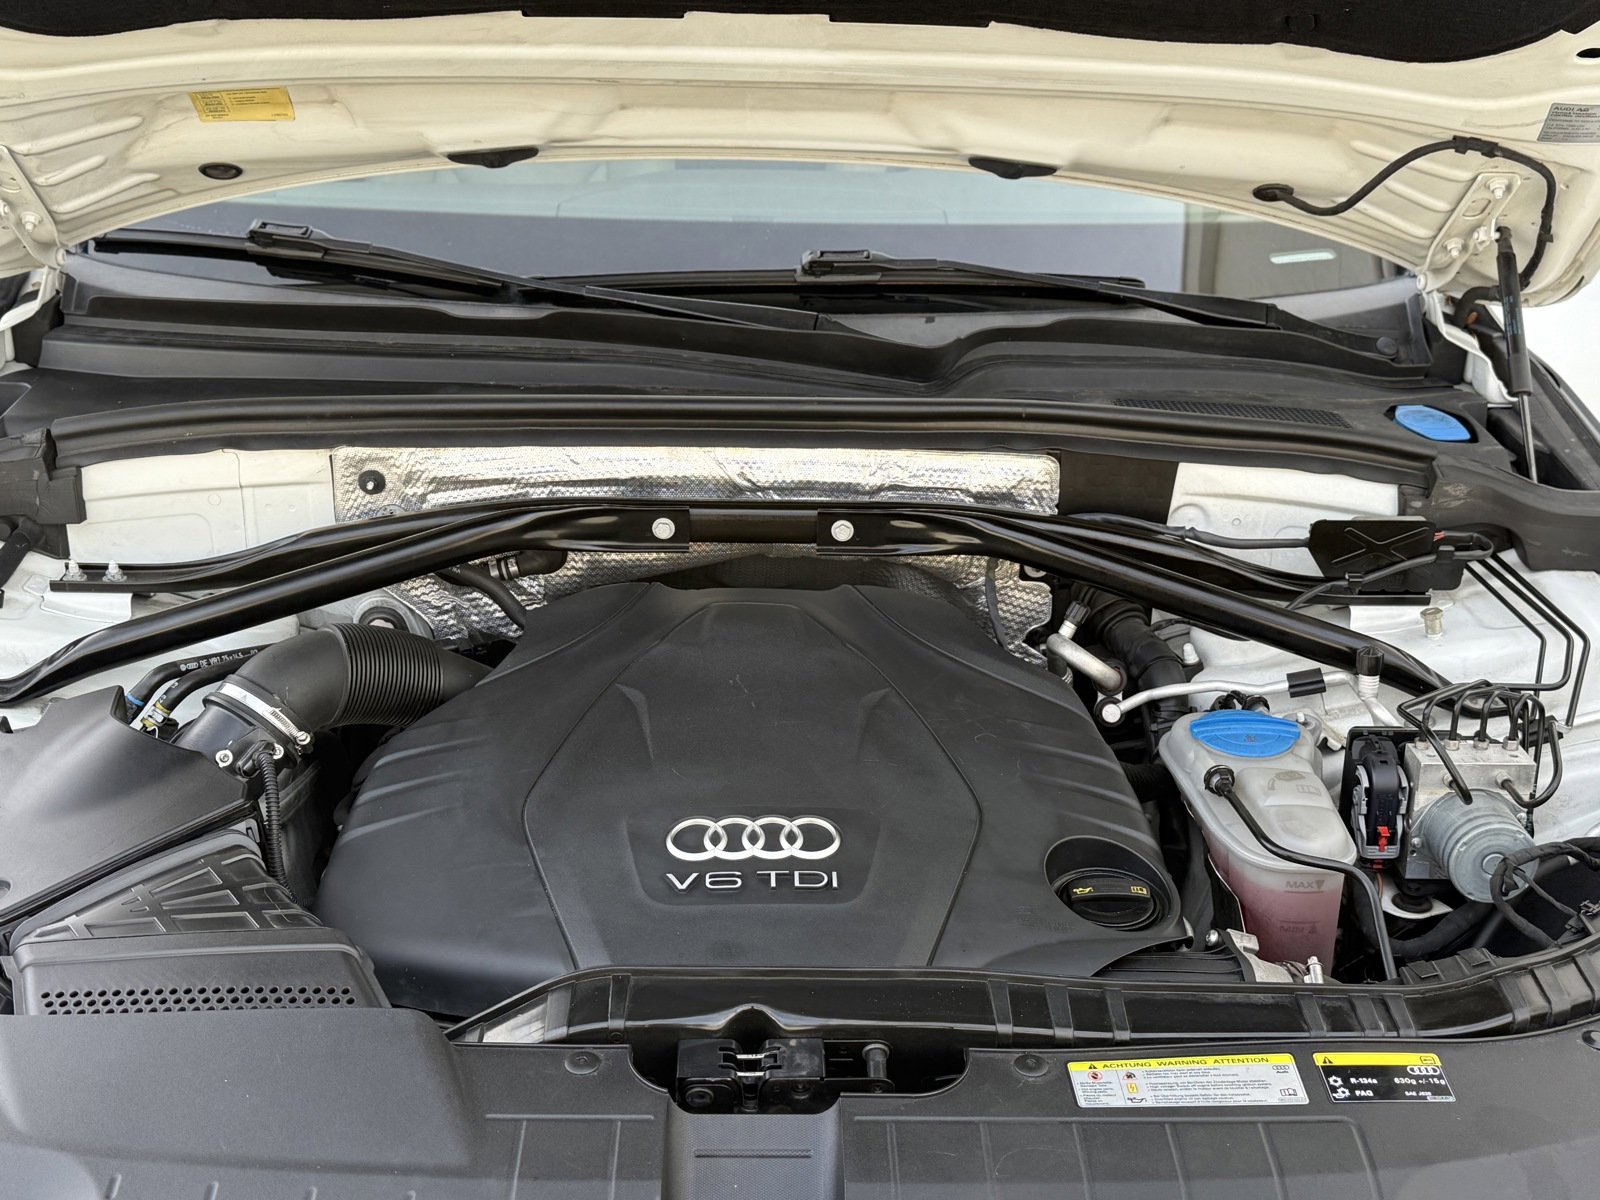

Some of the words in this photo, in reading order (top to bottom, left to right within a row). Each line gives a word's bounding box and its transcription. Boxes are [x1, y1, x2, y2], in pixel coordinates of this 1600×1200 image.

[665, 870, 742, 890] V6
[756, 870, 838, 889] TDI
[1285, 880, 1314, 889] MAX
[1279, 925, 1305, 933] MIN
[1102, 1061, 1152, 1069] ACHTUNG
[1157, 1059, 1207, 1067] WARNING
[1213, 1057, 1269, 1065] ATTENTION
